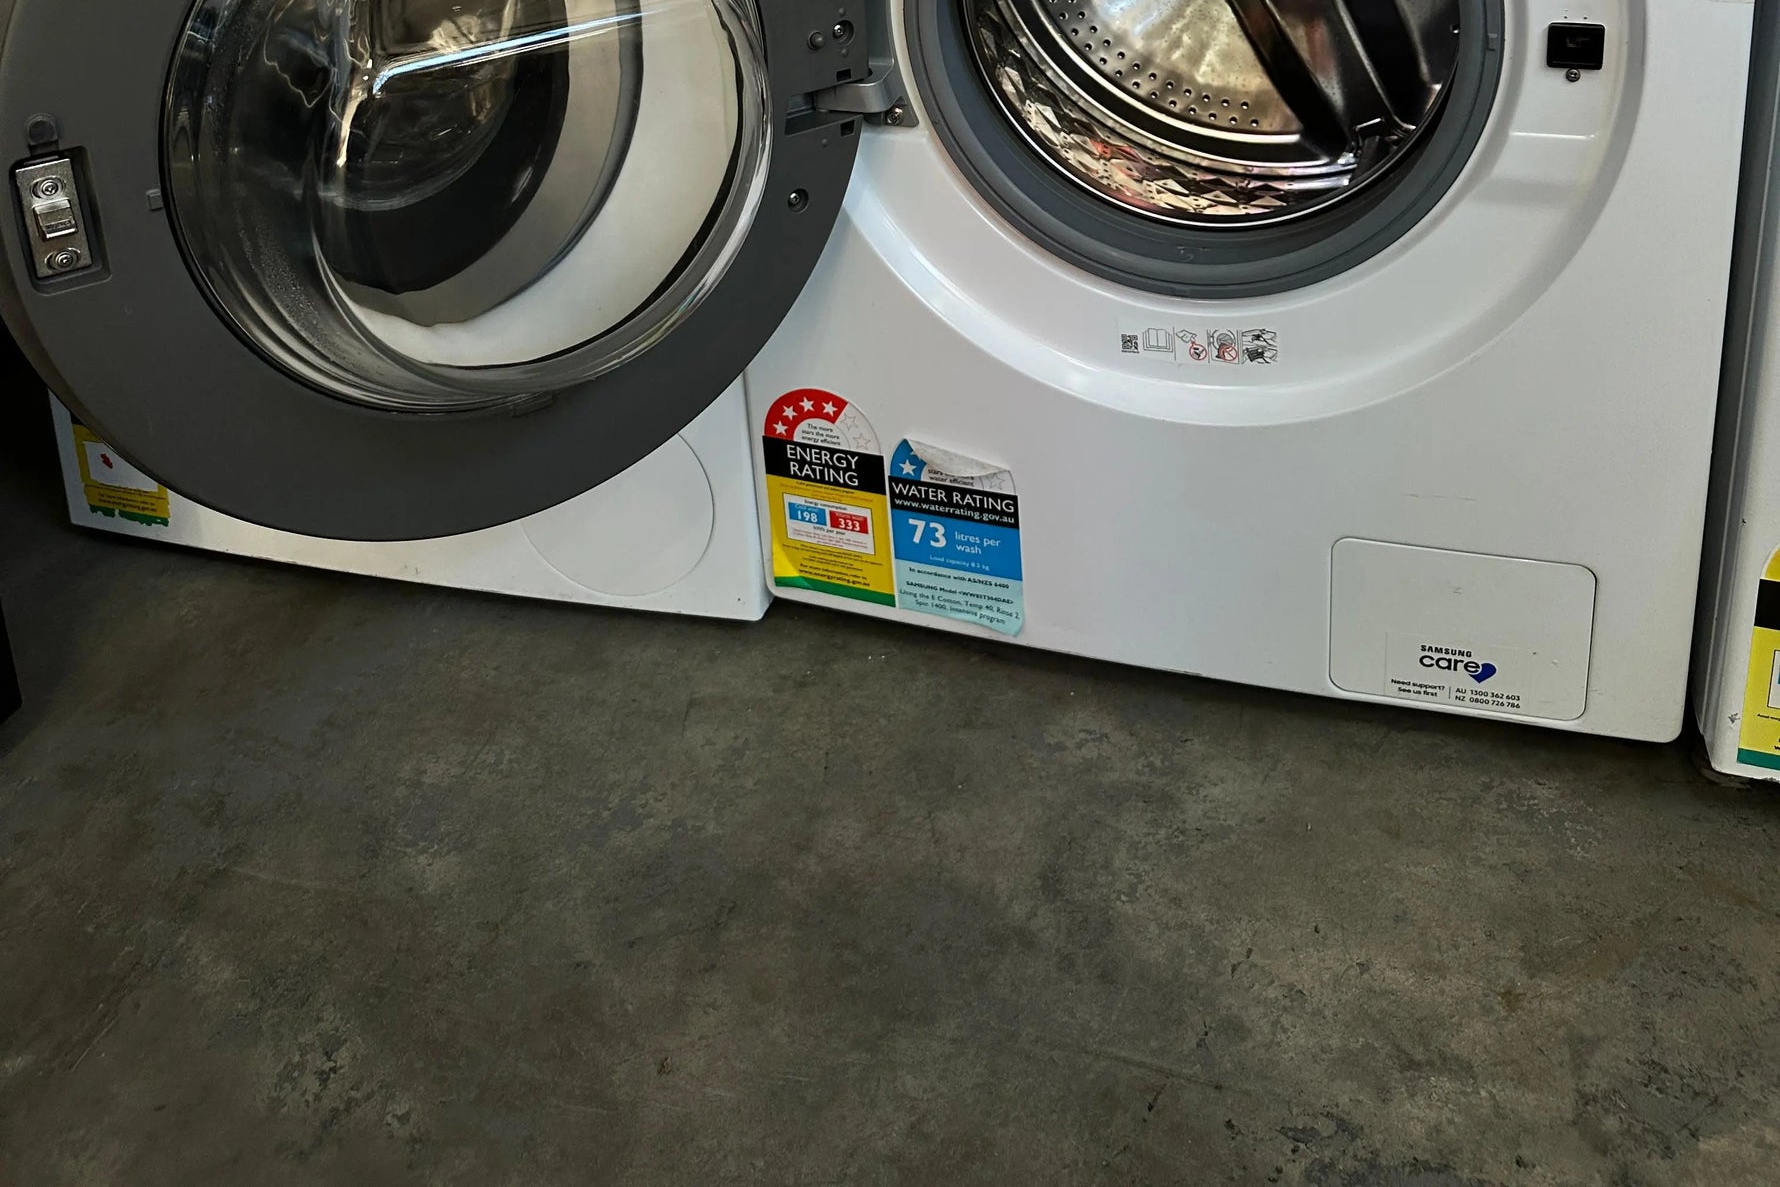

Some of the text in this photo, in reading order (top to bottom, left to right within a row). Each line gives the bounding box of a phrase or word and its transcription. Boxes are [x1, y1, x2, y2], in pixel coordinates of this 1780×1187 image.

[786, 444, 859, 469] ENERGY
[789, 461, 859, 486] RATING
[891, 482, 948, 503] WATER
[953, 491, 1015, 513] RATING
[797, 509, 818, 523] 198
[894, 498, 1015, 524] www.waterrating.gov.au
[838, 517, 861, 532] 333
[908, 518, 947, 548] 73
[955, 531, 1001, 548] litres per
[956, 543, 982, 554] wash
[979, 613, 1006, 625] program
[1420, 644, 1472, 658] SAMSUNG
[1419, 655, 1481, 674] care
[1391, 678, 1445, 691] Need support?
[1455, 687, 1521, 702] AU 1300 362 603
[1469, 697, 1490, 705] 0800
[1491, 699, 1505, 707] 726
